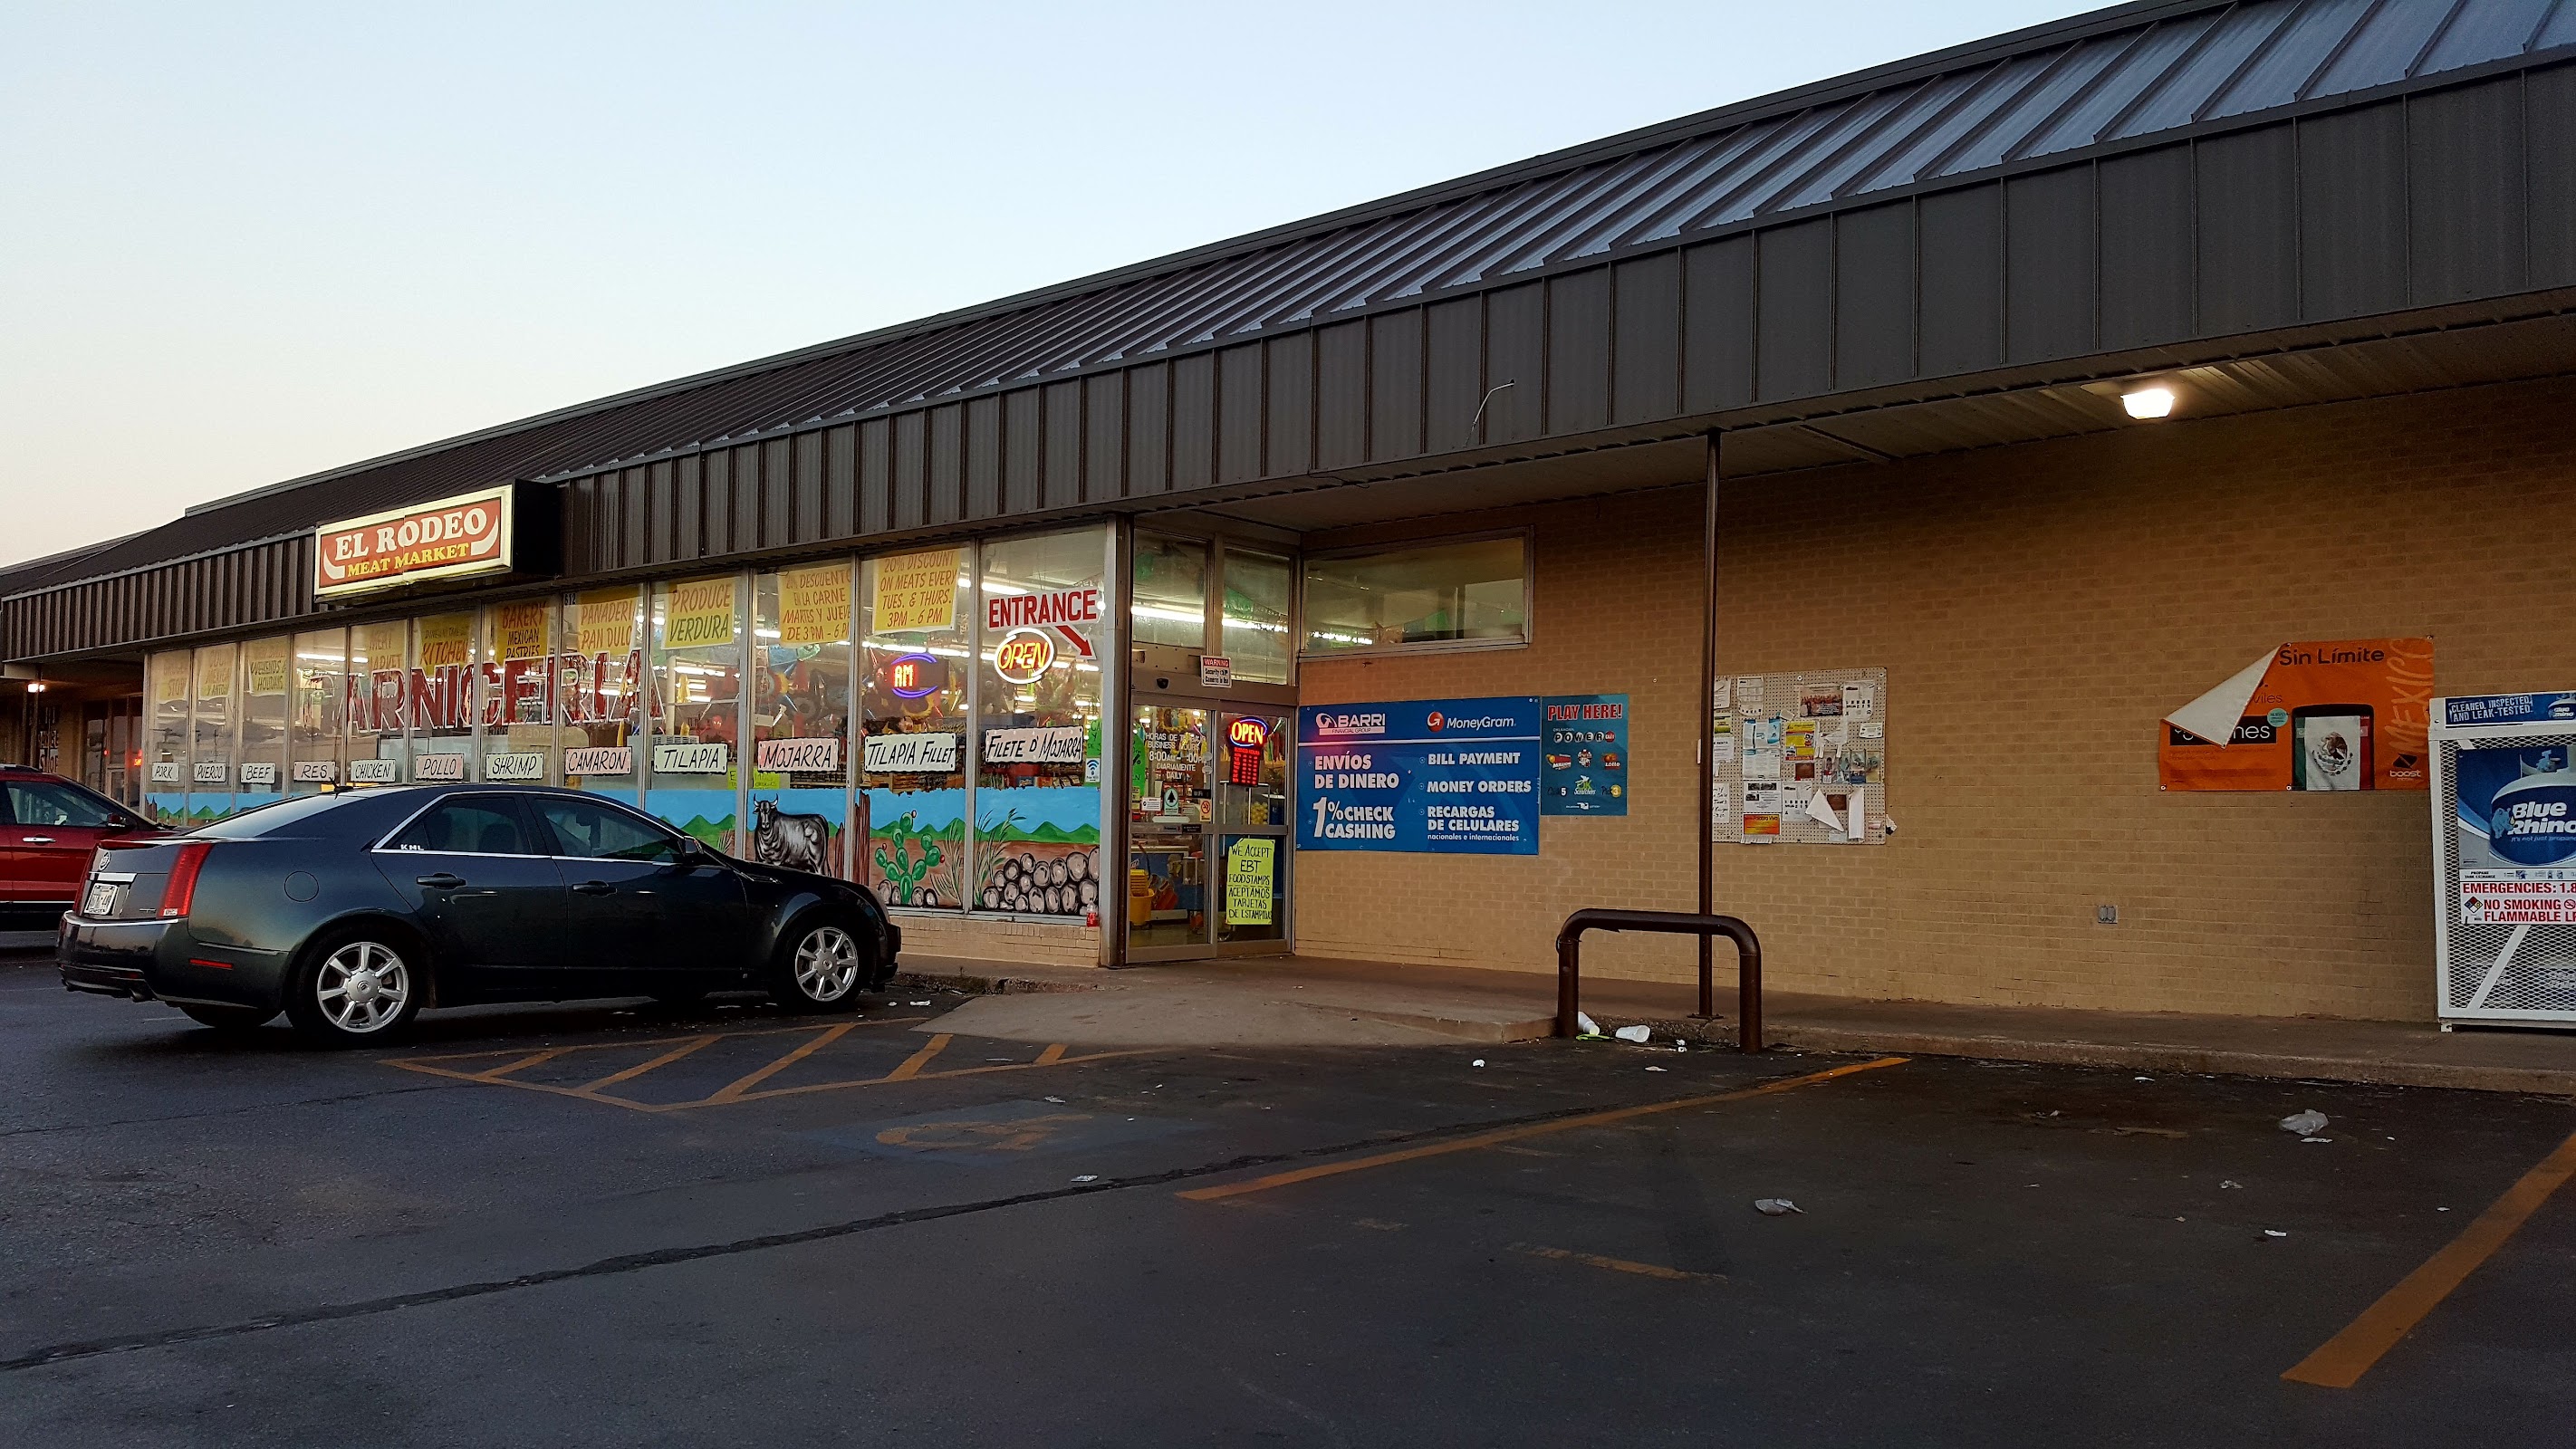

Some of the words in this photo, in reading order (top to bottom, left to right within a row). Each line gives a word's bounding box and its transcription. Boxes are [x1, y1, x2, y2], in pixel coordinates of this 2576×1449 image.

[334, 533, 369, 561] EL
[376, 508, 487, 552] RODEO
[347, 558, 390, 578] MEAT
[395, 543, 469, 569] MARKET
[884, 557, 904, 572] 20%
[907, 552, 953, 570] DISCOUNT
[880, 577, 892, 591] ON
[895, 573, 925, 589] MEATS
[928, 569, 957, 587] EVERY
[671, 584, 731, 613] PRODUCE
[803, 592, 811, 606] LA
[813, 588, 845, 605] CARNE
[882, 592, 904, 610] TUES.
[909, 592, 916, 605] &
[918, 589, 951, 606] THURS.
[503, 601, 546, 629] BAKERY
[783, 609, 813, 624] MARTES
[818, 609, 822, 619] Y
[918, 610, 923, 623] 6
[927, 608, 943, 623] PM
[989, 590, 1098, 629] ENTRANCE
[669, 614, 729, 642] VERDURA
[787, 626, 802, 640] DE
[834, 624, 839, 635] 6
[507, 629, 540, 645] MEXICAN
[582, 629, 603, 649] PAN
[420, 639, 469, 666] KITCHEN
[997, 642, 1049, 670] OPEN
[2279, 650, 2311, 665] Sin
[2318, 648, 2385, 664] Límite
[1204, 658, 1228, 667] WARNING
[894, 665, 913, 687] AM
[1337, 713, 1386, 727] BARRI
[1548, 705, 1580, 721] PLAY
[1583, 704, 1623, 720] HERE!
[2453, 713, 2469, 723] AND
[1447, 715, 1514, 731] MoneyGram
[1169, 734, 1177, 742] DE
[1232, 722, 1264, 744] OPEN
[867, 740, 917, 766] TILAPIA
[922, 742, 955, 765] FILLET
[987, 734, 1025, 760] FILETE
[1041, 733, 1082, 758] MOJARRA
[1148, 741, 1176, 749] BUSINESS
[569, 750, 628, 772] CAMARON
[663, 748, 719, 768] TILAPIA
[764, 744, 831, 769] MOJARRA
[1314, 750, 1372, 770] ENVÍOS
[1428, 753, 1456, 764] BILL
[1459, 753, 1521, 764] PAYMENT
[155, 765, 174, 779] PORK
[245, 765, 270, 780] BEEF
[301, 764, 328, 779] RES
[355, 763, 390, 779] CHICKEN
[422, 758, 457, 775] POLLO
[493, 754, 537, 777] SHRIMP
[1157, 763, 1196, 772] DIARIAMENTE
[1314, 774, 1334, 788] DE
[1339, 773, 1399, 789] DINERO
[2389, 770, 2421, 778] boost
[1427, 782, 1474, 792] MONEY
[1478, 781, 1532, 792] ORDERS
[1345, 806, 1394, 822] CHECK
[1427, 806, 1495, 818] RECARGAS
[2513, 801, 2567, 819] Blue
[1325, 823, 1396, 839] CASHING
[1427, 820, 1446, 830] DE
[1448, 820, 1520, 831] CELULARES
[1232, 844, 1243, 856] WE
[1245, 844, 1272, 858] ACCEPT
[1240, 860, 1261, 873] EBT
[1228, 888, 1270, 898] ACEPTAMOS
[2463, 883, 2556, 893] EMERGENCIES:
[1233, 898, 1267, 909] TARJETAS
[2485, 899, 2500, 909] NO
[2504, 899, 2561, 909] SMOKING
[1229, 909, 1239, 918] DE
[2485, 911, 2561, 921] FLAMMABLE
